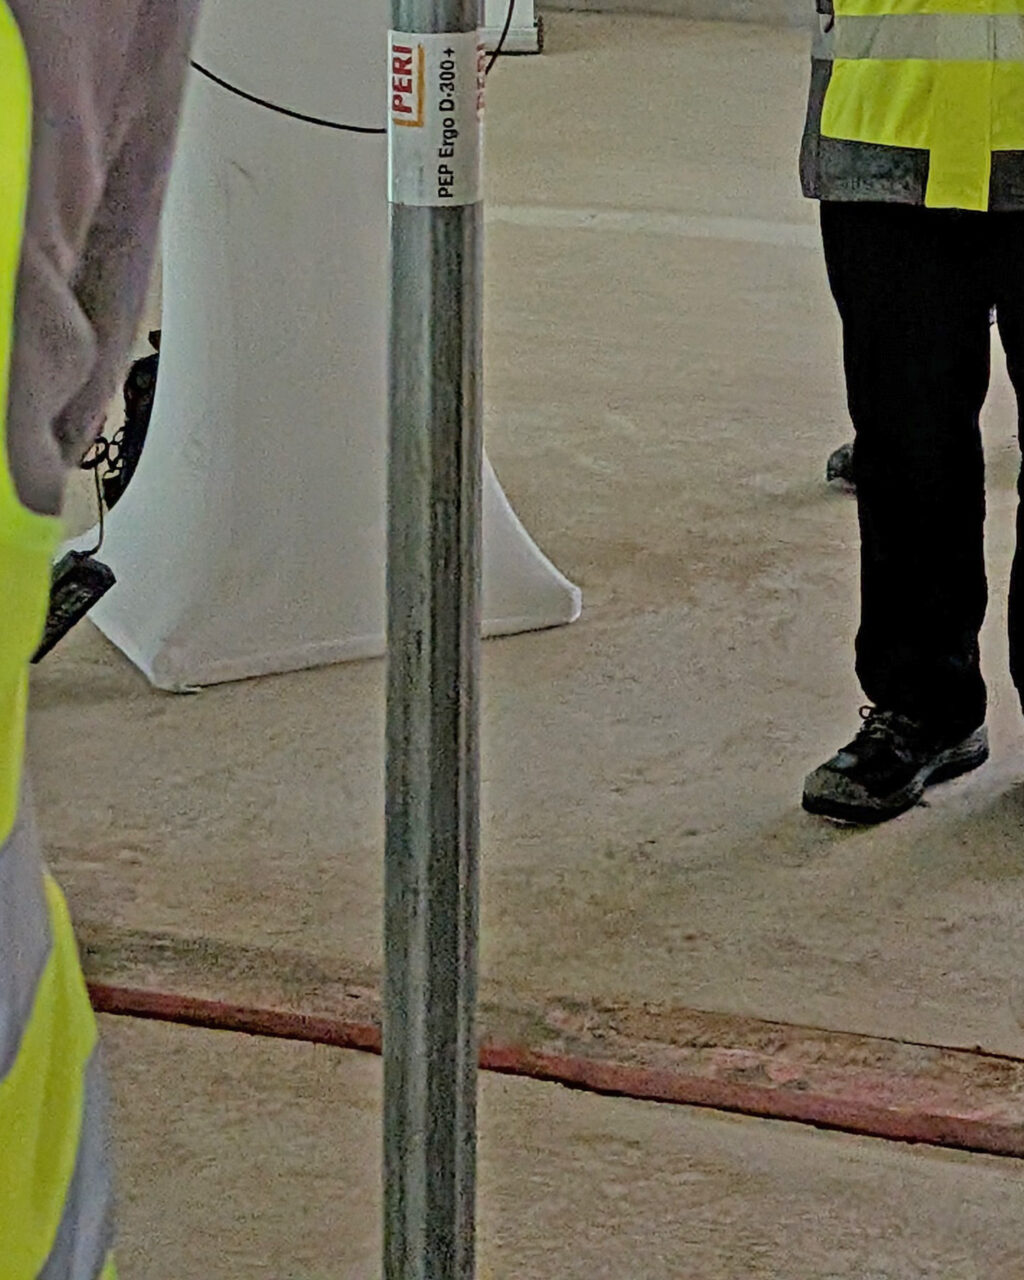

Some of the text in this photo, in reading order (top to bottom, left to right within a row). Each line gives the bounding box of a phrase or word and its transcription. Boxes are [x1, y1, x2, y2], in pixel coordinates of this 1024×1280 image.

[392, 45, 413, 114] PERI
[438, 117, 460, 158] Ergo
[438, 164, 454, 198] PEP
